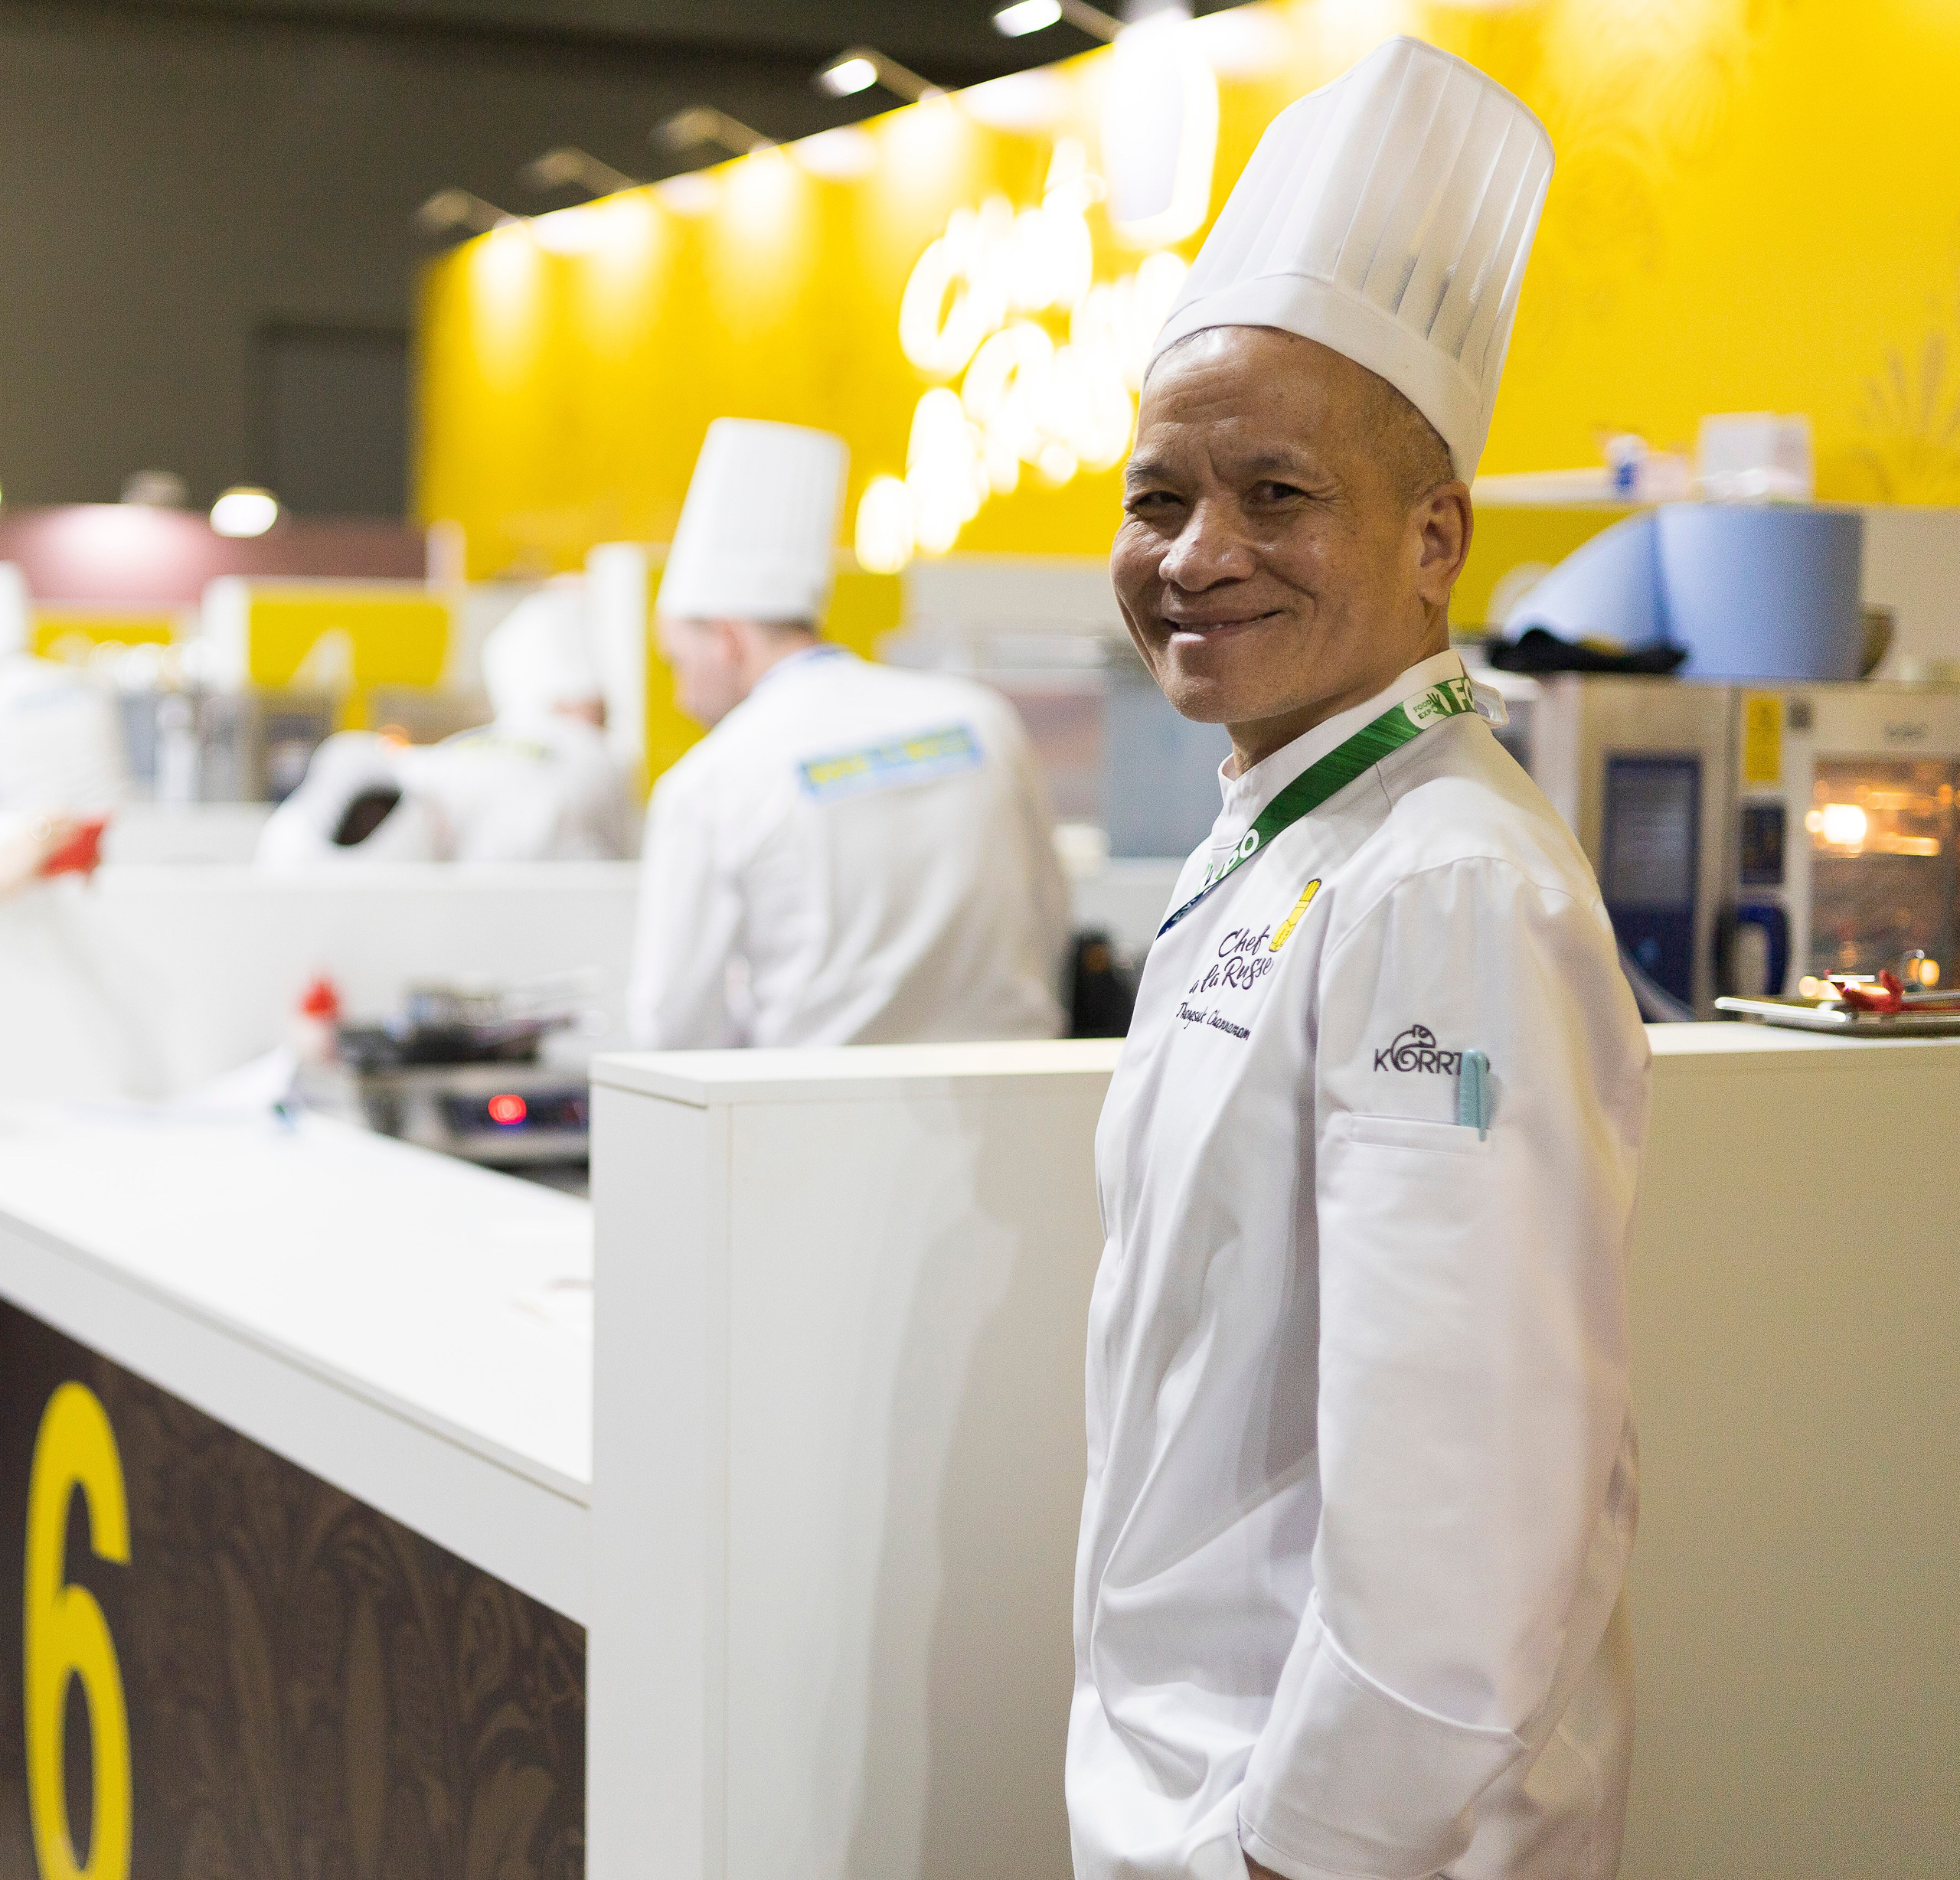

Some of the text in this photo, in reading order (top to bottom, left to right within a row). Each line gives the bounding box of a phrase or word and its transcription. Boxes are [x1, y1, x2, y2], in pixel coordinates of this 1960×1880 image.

[1413, 700, 1432, 713] FOOD
[1218, 924, 1270, 958] Chef
[1200, 964, 1220, 993] la
[1221, 956, 1274, 990] Russe
[24, 1381, 132, 1880] 6
